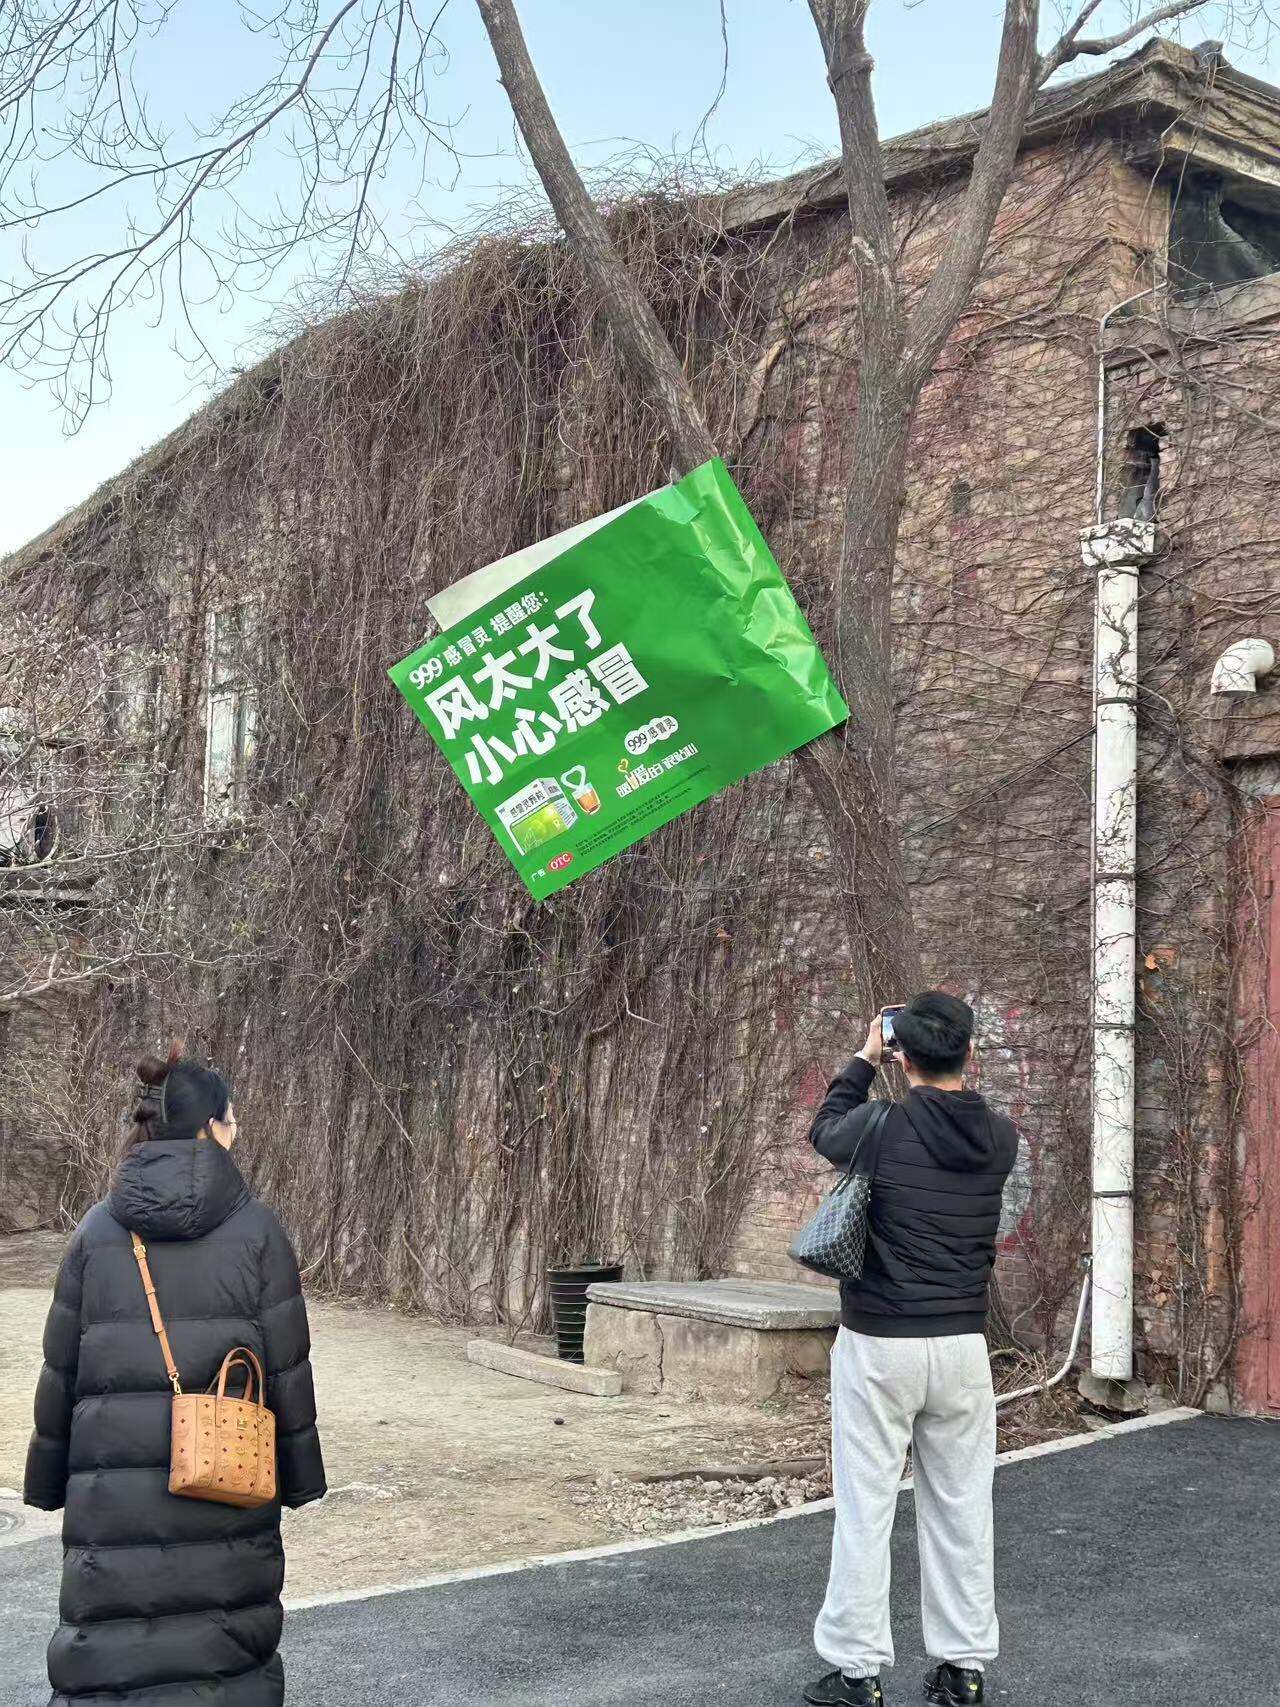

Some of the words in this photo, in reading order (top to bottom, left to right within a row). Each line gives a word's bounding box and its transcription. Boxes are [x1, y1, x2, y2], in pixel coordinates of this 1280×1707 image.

[408, 657, 443, 690] 999
[443, 625, 492, 667] 感冒灵
[424, 588, 601, 740] 风太大了
[463, 641, 650, 786] 小心感冒
[627, 732, 648, 752] 999
[550, 853, 571, 870] OTC
